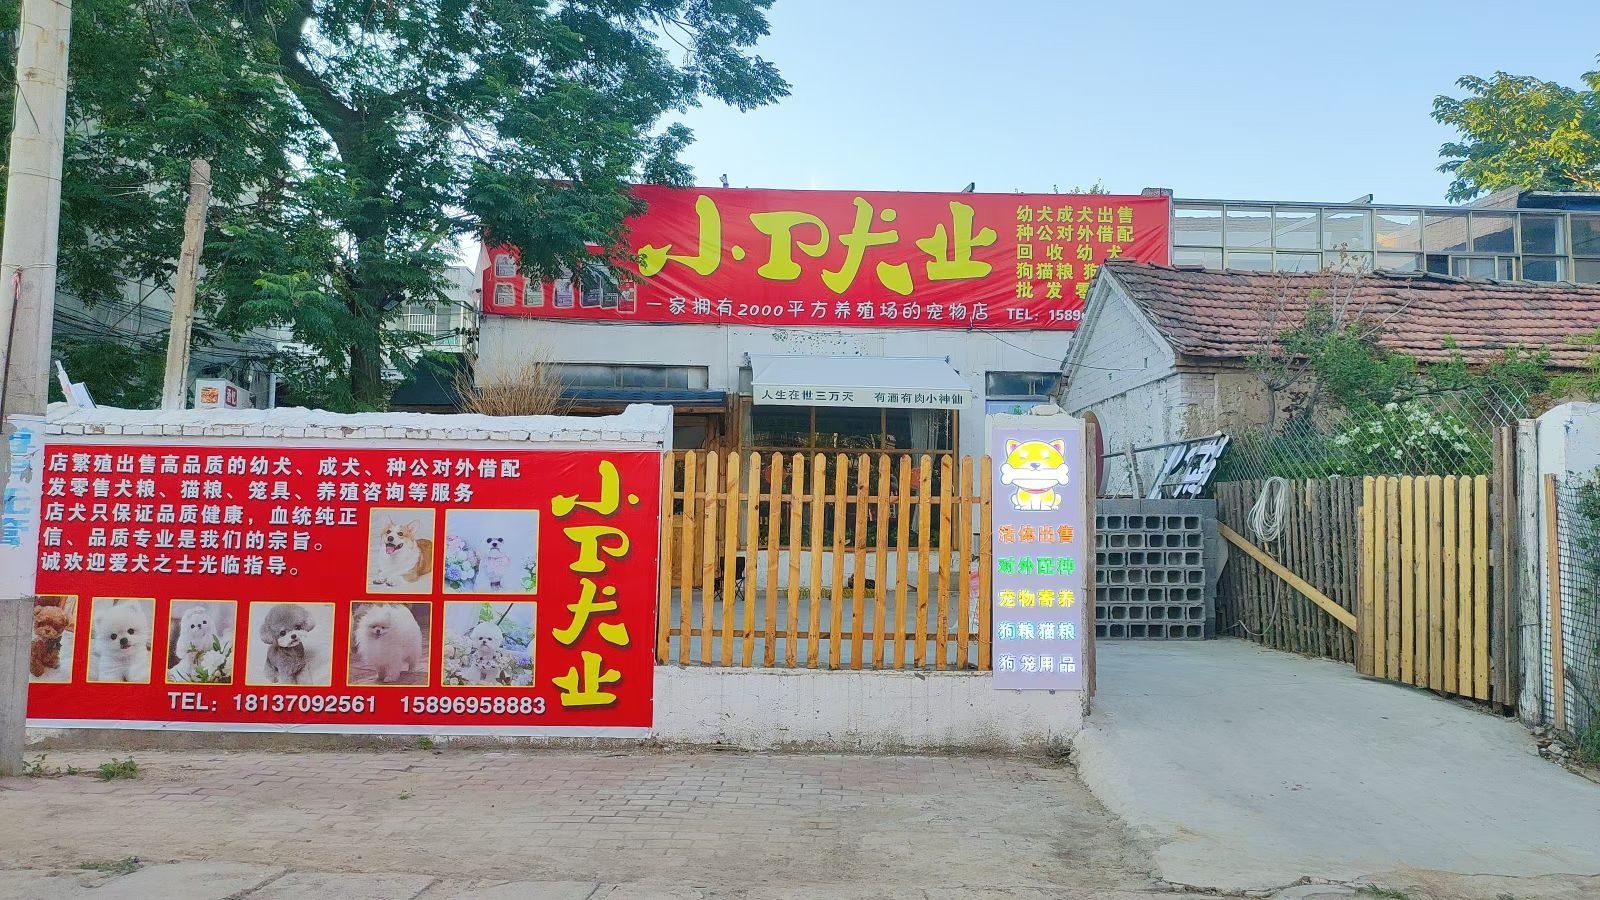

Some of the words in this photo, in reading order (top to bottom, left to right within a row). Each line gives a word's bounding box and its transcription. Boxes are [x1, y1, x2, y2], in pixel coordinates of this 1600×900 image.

[1016, 205, 1135, 223] 幼犬成犬出售
[1016, 224, 1135, 243] 种公对外借配
[1016, 243, 1123, 261] 回收幼犬
[646, 295, 989, 322] 一家拥有2000平方养殖场的宠物店
[761, 389, 854, 403] 人生在世三万天
[874, 391, 963, 405] 有酒有肉小神仙
[43, 452, 521, 478] 店繁殖出售高品质的幼犬、成犬、种公对外借配
[41, 477, 474, 503] 发零售犬粮、猫粮、笼具、养殖咨询等服务
[44, 501, 358, 526] 店犬只保证品质健康，血统纯正
[42, 526, 323, 551] 信、品质专业是我们的宗旨。
[40, 551, 299, 577] 诚欢迎爱犬之士光临指导。
[998, 556, 1076, 575] 对外配种
[998, 589, 1075, 608] 宠物寄养
[998, 621, 1076, 640] 狗粮猫粮
[999, 653, 1076, 673] 狗笼用品
[233, 694, 376, 713] 18137092561
[400, 696, 546, 714] 15896958883
